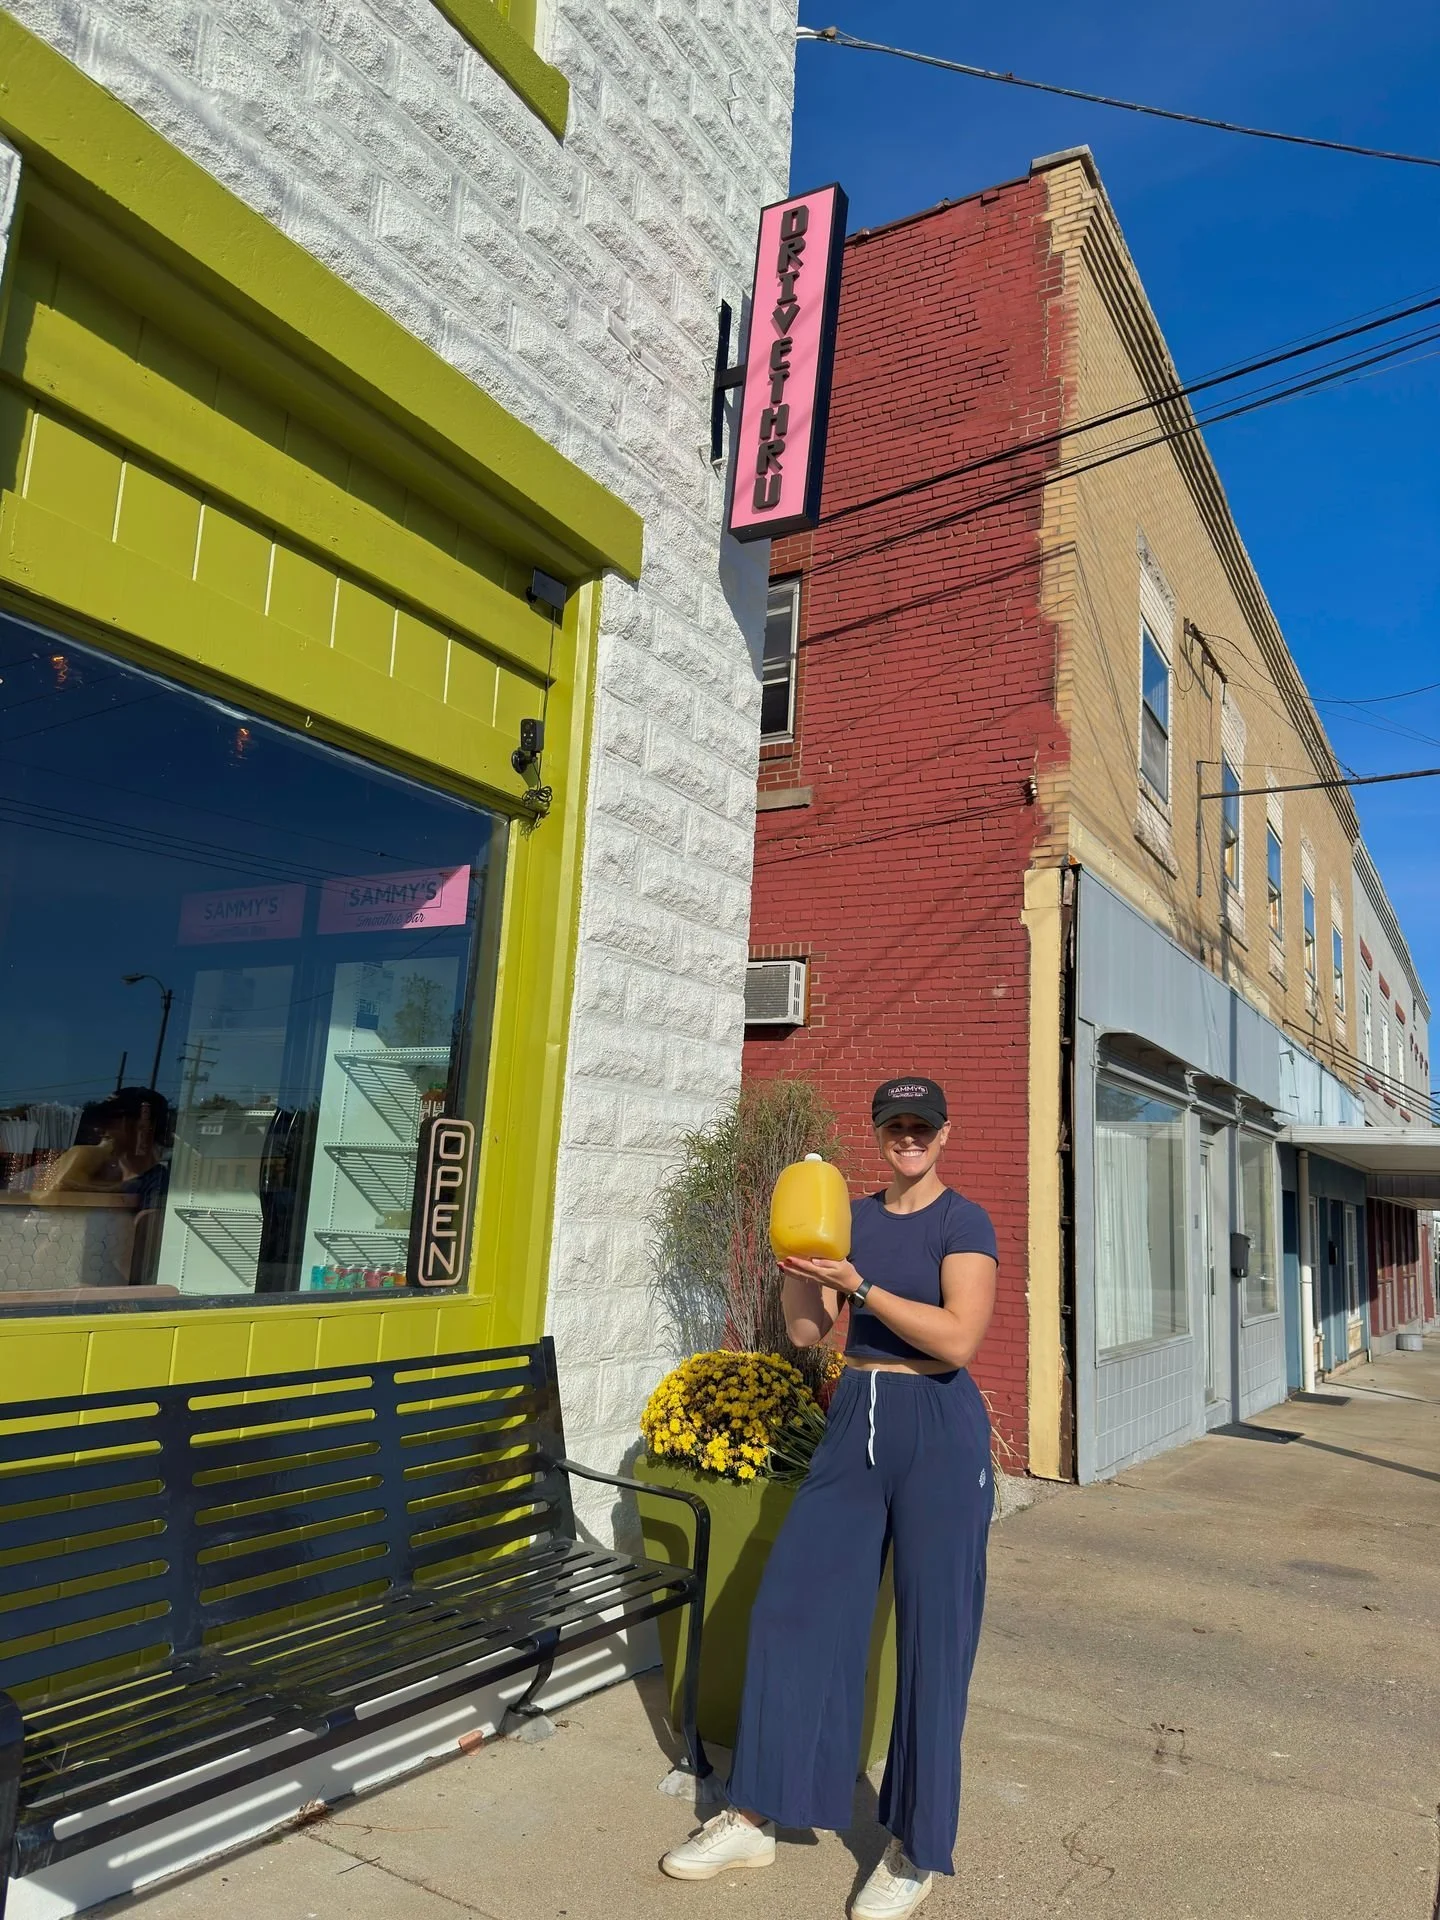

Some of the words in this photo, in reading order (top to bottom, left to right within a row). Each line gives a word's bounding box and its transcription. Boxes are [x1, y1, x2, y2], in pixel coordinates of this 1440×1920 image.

[349, 881, 437, 907] SAMMY'S
[204, 897, 279, 920] SAMMY'S
[405, 911, 425, 924] Bar
[427, 1130, 466, 1277] OPEN
